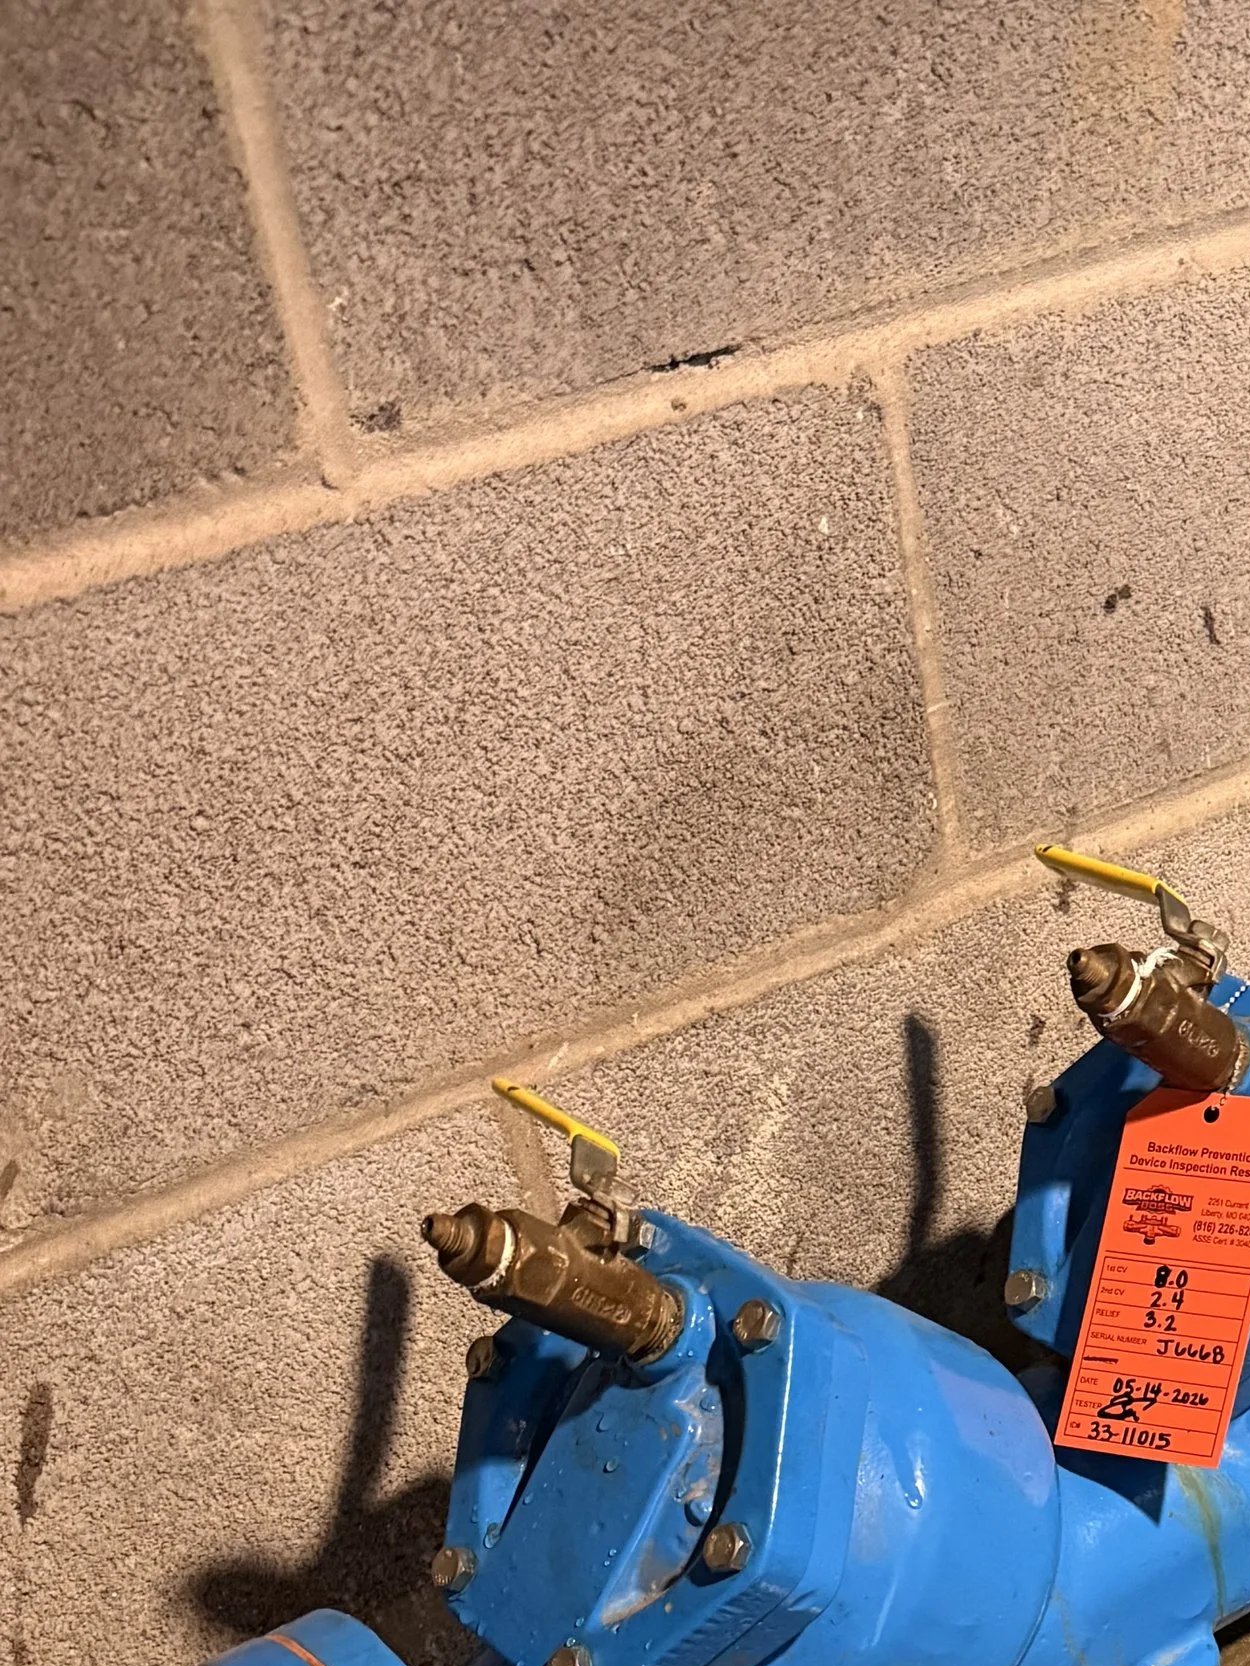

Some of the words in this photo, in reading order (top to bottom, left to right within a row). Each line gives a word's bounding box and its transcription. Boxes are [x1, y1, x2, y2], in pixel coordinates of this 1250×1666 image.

[1147, 1141, 1198, 1157] Backflow
[1129, 1153, 1167, 1168] Device
[1169, 1159, 1227, 1175] Inspection
[1125, 1189, 1192, 1208] BACKFLOW
[1192, 1220, 1216, 1235] (816)
[1117, 1265, 1128, 1274] CV
[1154, 1265, 1189, 1288] 8.0
[1114, 1287, 1126, 1296] CV
[1150, 1289, 1185, 1311] 2.4
[1095, 1307, 1121, 1318] RELIEF
[1143, 1310, 1177, 1332] 3.2
[1090, 1331, 1115, 1342] SERIAL
[1116, 1335, 1148, 1346] NUMBER
[1079, 1376, 1099, 1386] DATE
[1112, 1377, 1210, 1406] 05-14-2026
[1087, 1421, 1172, 1450] 33-11015
